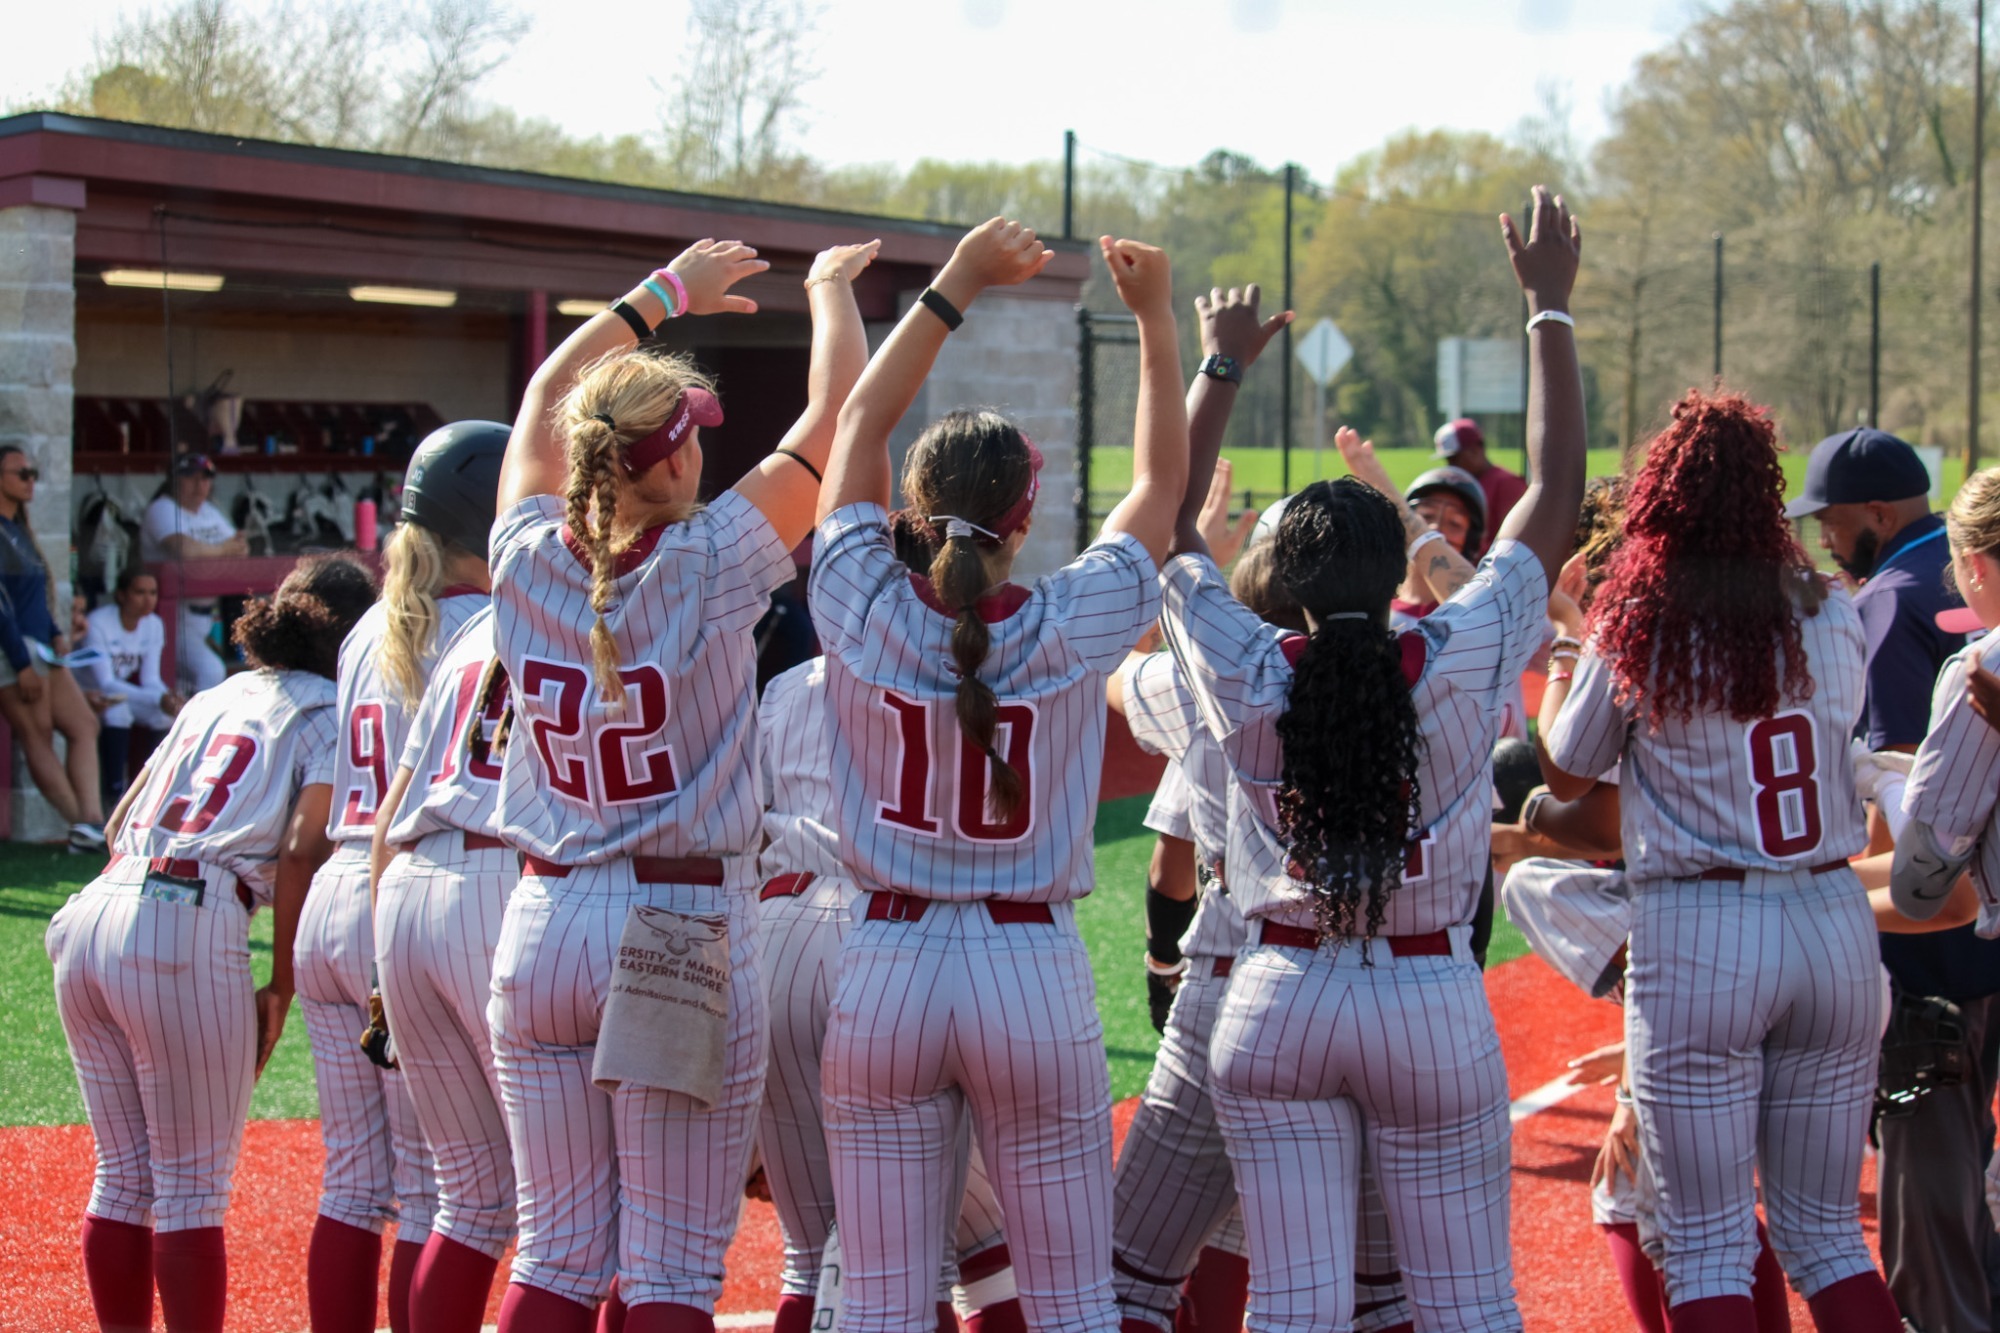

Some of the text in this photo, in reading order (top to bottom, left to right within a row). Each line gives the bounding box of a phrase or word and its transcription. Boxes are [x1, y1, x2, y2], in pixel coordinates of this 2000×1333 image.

[130, 732, 260, 838] 13
[342, 698, 389, 828] 9
[518, 653, 682, 808] 22
[874, 689, 1039, 844] 10
[1744, 708, 1825, 862] 8
[619, 959, 723, 994] EASTERN SHORE
[620, 946, 667, 963] ERSITY
[624, 985, 679, 1003] Admissions
[680, 999, 699, 1009] and
